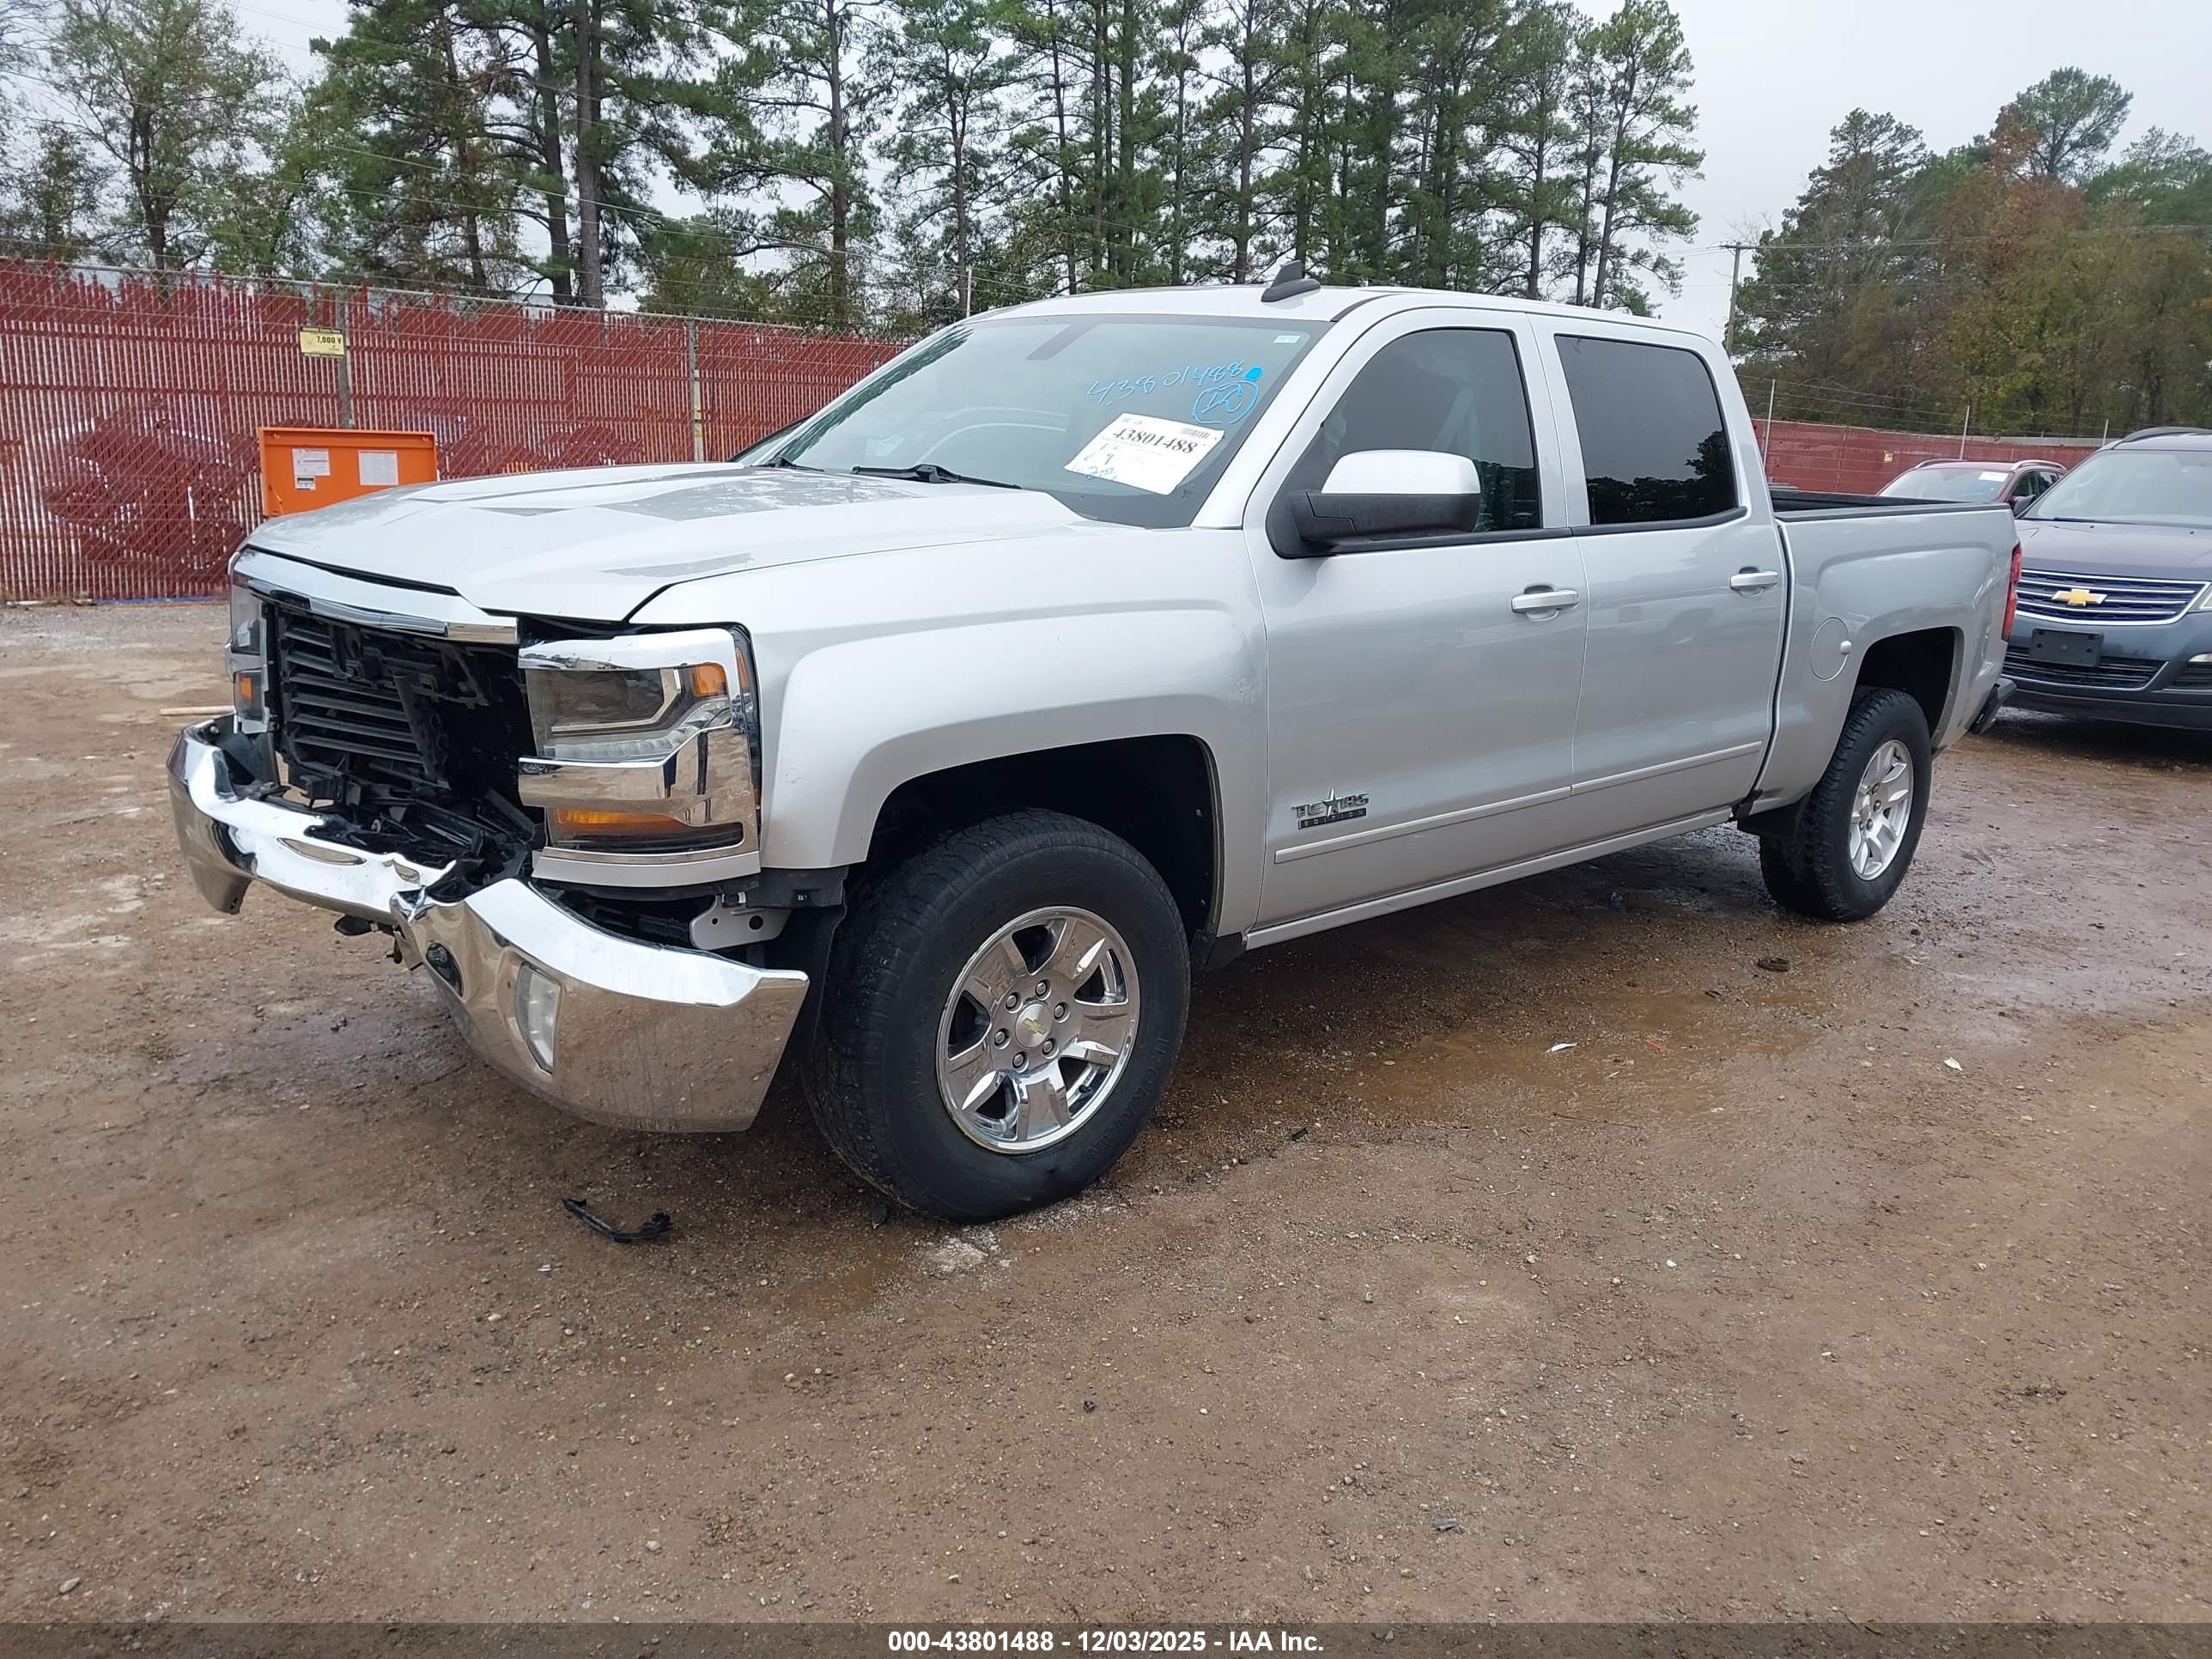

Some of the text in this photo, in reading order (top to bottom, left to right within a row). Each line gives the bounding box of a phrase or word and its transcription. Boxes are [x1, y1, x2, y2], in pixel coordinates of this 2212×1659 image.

[316, 335, 336, 344] 7,000
[1086, 360, 1244, 405] 43801488
[1113, 428, 1198, 454] 43801488
